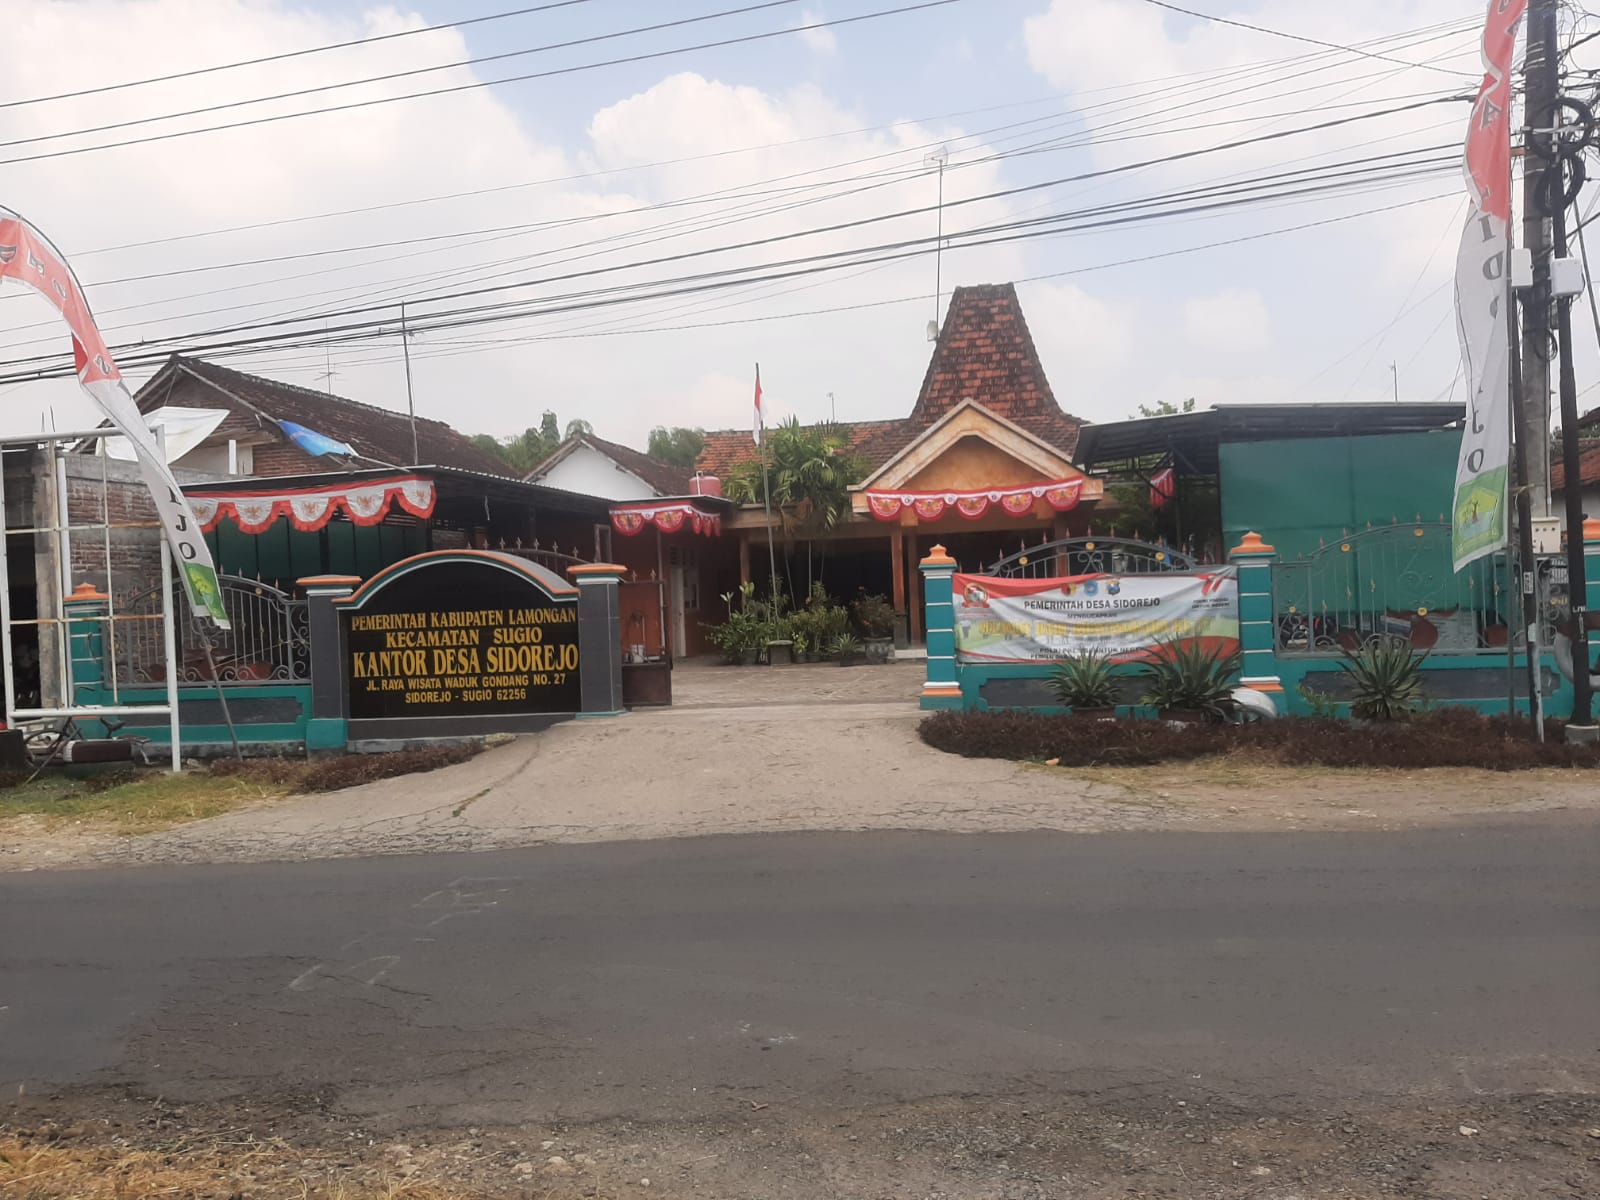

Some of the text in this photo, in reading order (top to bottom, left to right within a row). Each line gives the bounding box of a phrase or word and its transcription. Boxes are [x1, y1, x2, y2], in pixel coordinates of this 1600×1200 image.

[1024, 597, 1161, 610] PEMERINTAH DESA SIDOREJO
[352, 607, 576, 631] PEMERINTAH KABUPATEN LAMONGAN
[386, 627, 543, 649] KECAMATAN SUGIO
[353, 644, 579, 678] KANTOR DESA SIDOREJO
[366, 672, 566, 691] JL. RAYA WISATA WADUK GONDANG NO. 27
[405, 690, 452, 704] SIDOREJO
[462, 689, 492, 702] SUGIO
[496, 688, 527, 701] 62256
